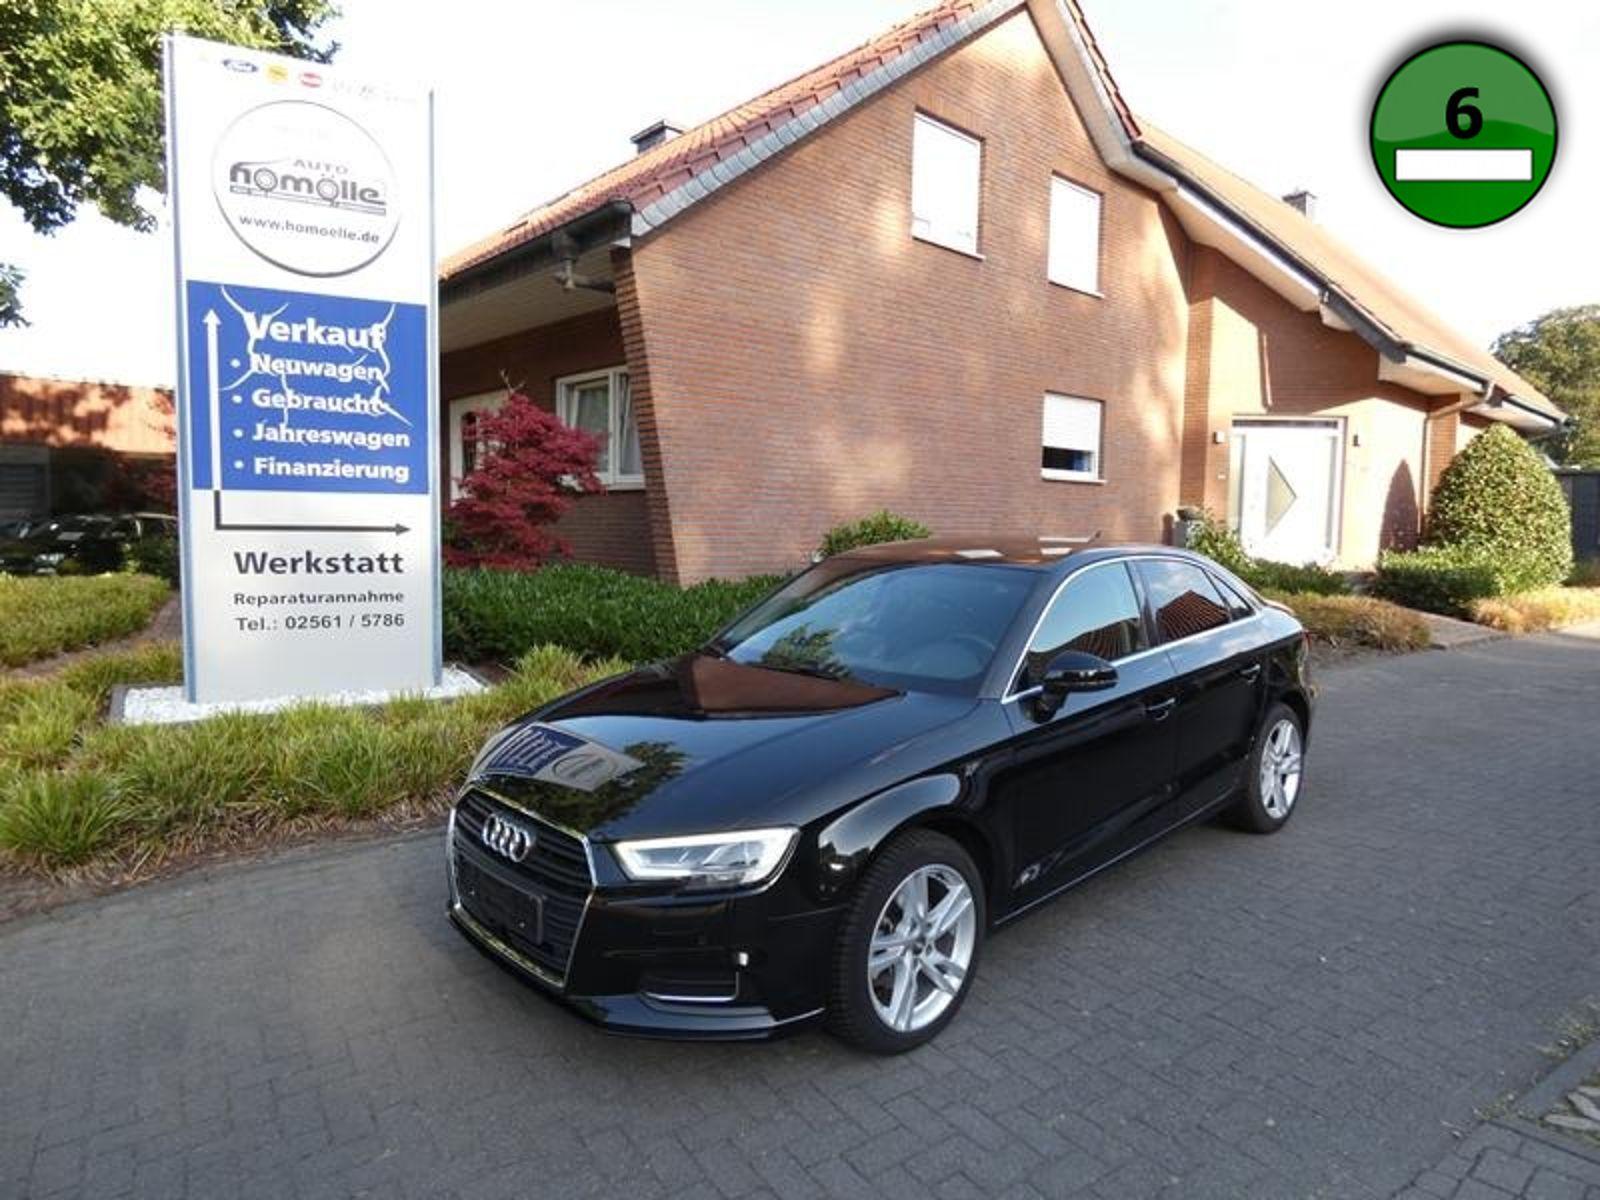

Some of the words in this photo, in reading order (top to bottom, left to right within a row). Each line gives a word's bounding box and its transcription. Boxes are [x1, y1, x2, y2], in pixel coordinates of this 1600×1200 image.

[293, 159, 348, 174] AUTO
[239, 214, 380, 243] www.homoelle.de
[245, 311, 386, 350] Verkauf
[251, 353, 384, 382] Neuwagen
[252, 423, 411, 450] Jahreswagen
[254, 456, 410, 483] Finanzierung
[234, 550, 404, 575] Werkstatt
[234, 590, 405, 608] Reparaturannahme
[235, 617, 278, 631] Tel.:
[285, 614, 342, 630] 02561
[349, 615, 356, 629] /
[361, 613, 405, 628] 5786
